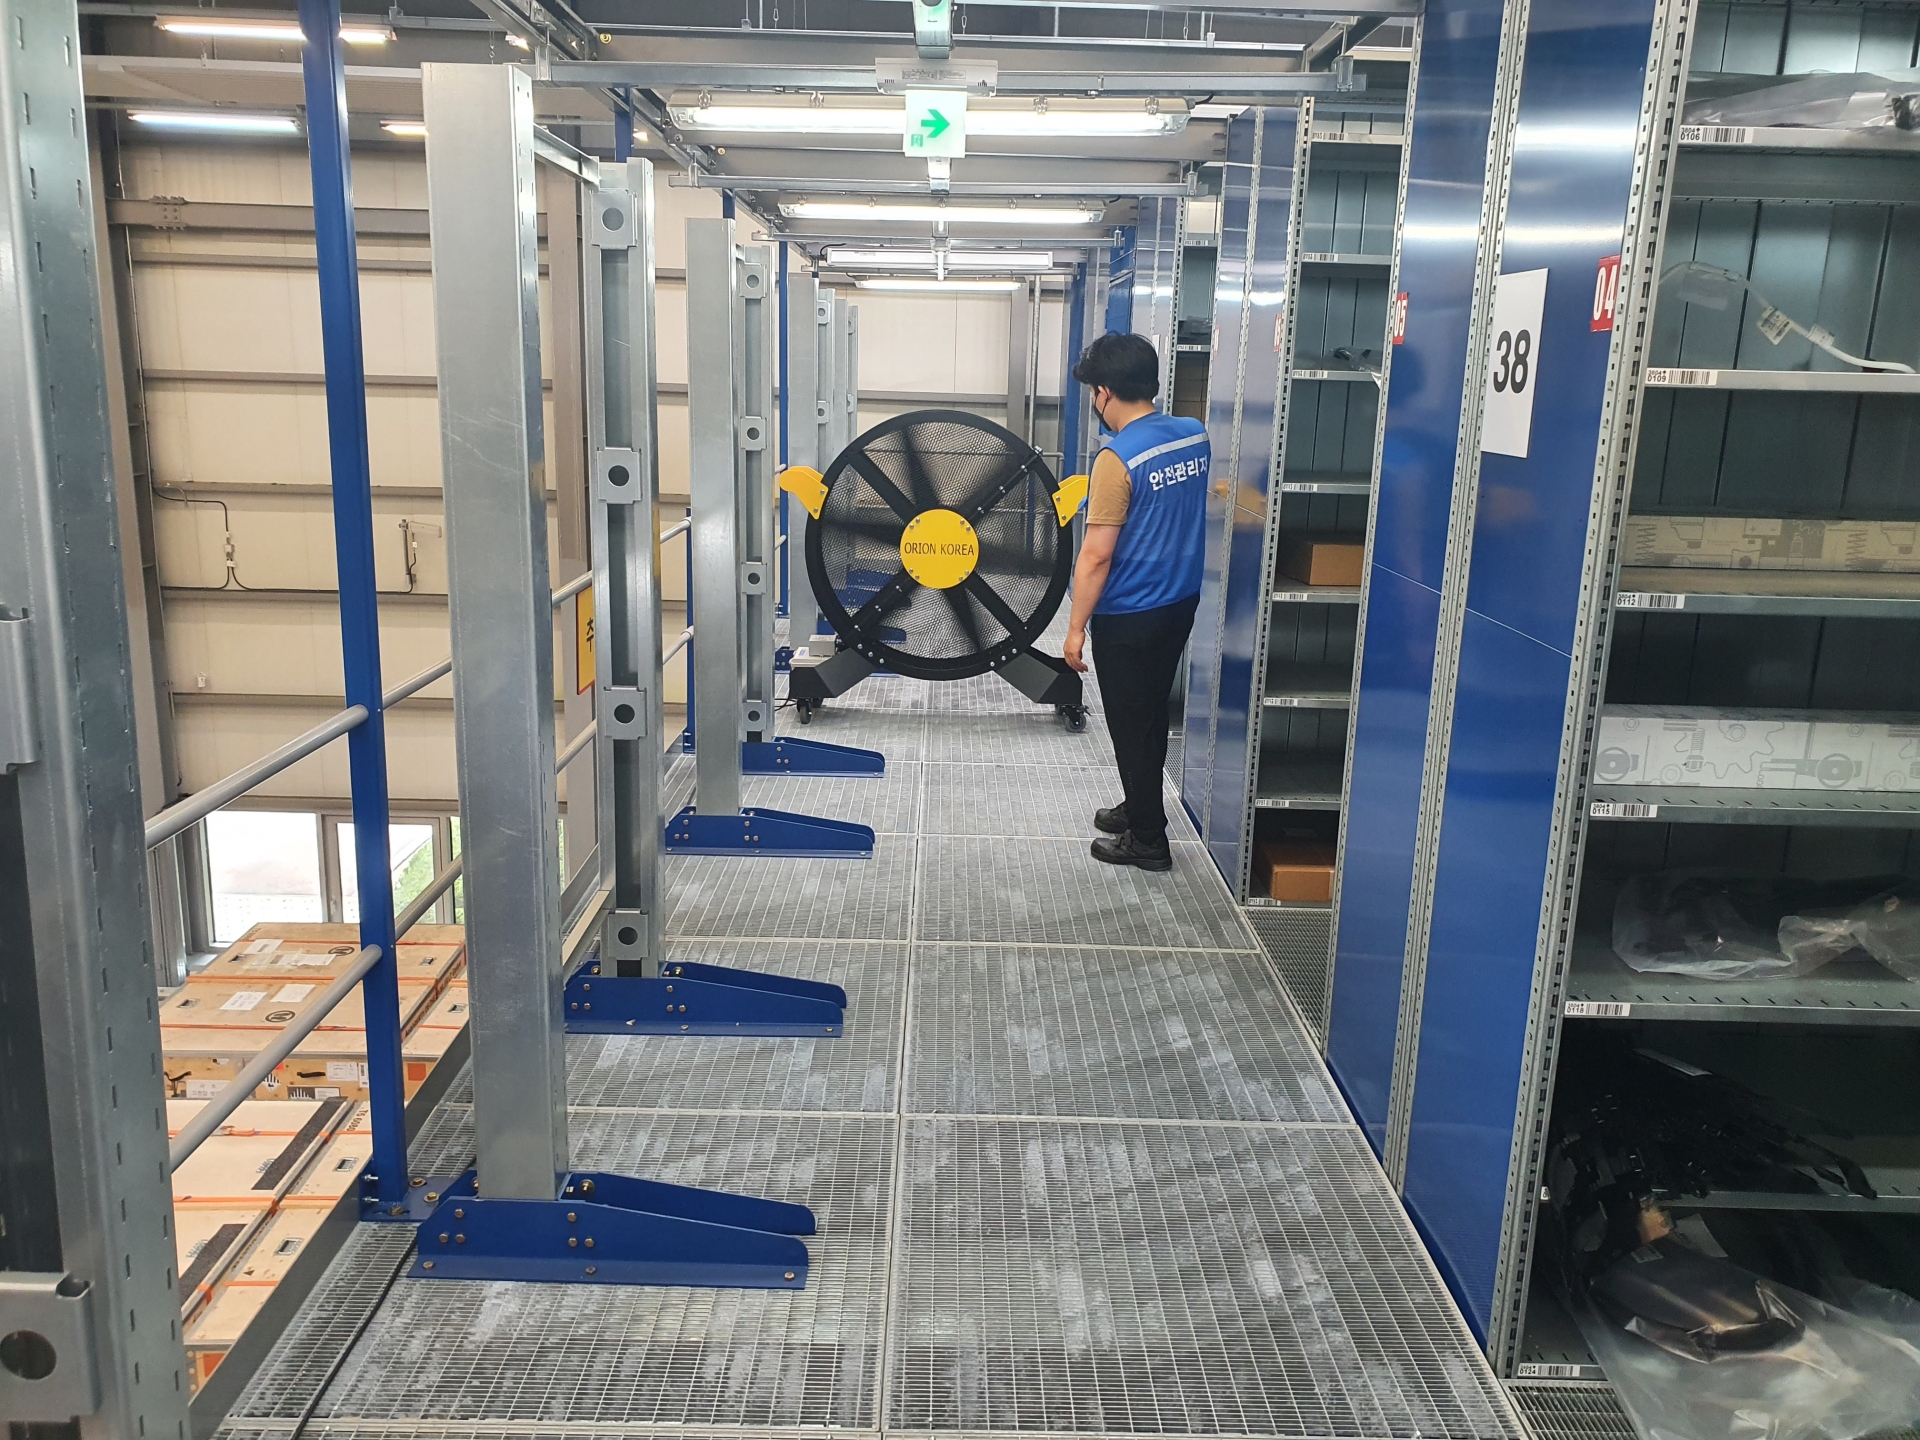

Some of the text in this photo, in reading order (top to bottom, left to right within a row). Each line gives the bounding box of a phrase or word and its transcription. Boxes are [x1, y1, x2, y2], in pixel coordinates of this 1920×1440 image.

[1680, 133, 1700, 141] 0106
[1593, 265, 1618, 321] 04
[1394, 299, 1408, 337] 05
[1493, 329, 1531, 394] 38
[904, 542, 975, 556] ORION KOREA
[1617, 598, 1636, 606] 0112
